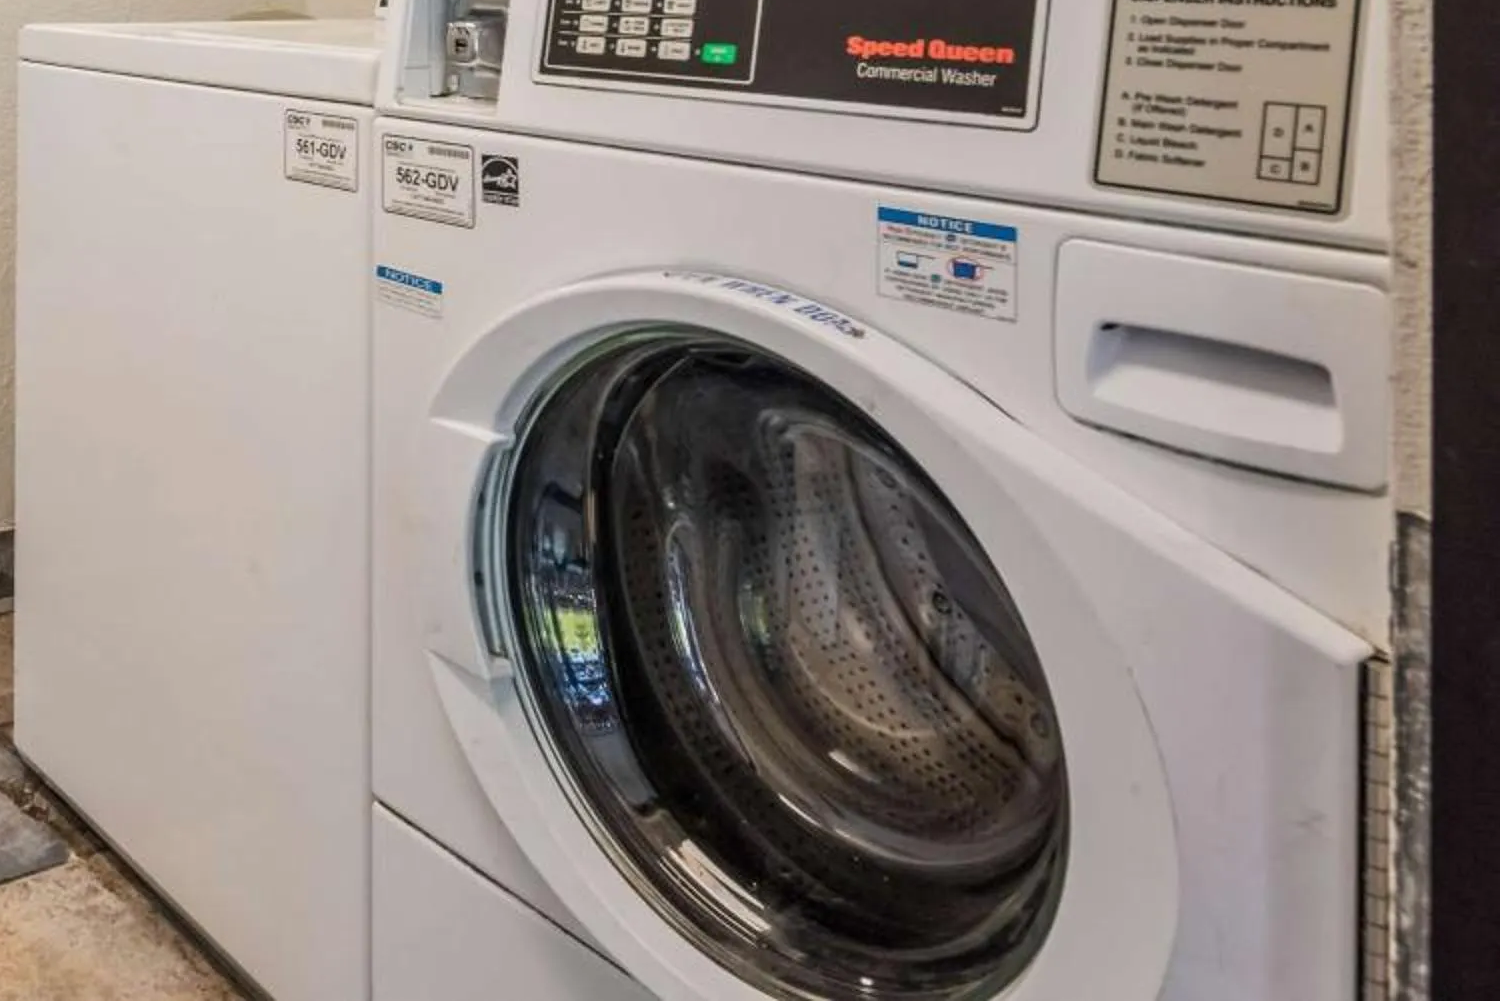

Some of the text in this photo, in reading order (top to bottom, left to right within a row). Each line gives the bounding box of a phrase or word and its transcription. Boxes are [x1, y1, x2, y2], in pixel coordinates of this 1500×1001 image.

[1141, 15, 1166, 26] Open
[1169, 16, 1218, 28] Dispenser
[1220, 18, 1245, 29] Door
[846, 35, 1016, 64] Speed Queen
[1136, 46, 1149, 54] as
[1138, 33, 1163, 43] Load
[1166, 34, 1207, 46] Supplies
[1209, 36, 1218, 45] in
[1220, 36, 1255, 49] Proper
[1257, 39, 1331, 52] Compartment
[1136, 57, 1164, 67] Close
[1166, 58, 1215, 71] Dispenser
[1218, 61, 1242, 73] Door
[856, 62, 997, 87] Commercial Washer
[1155, 93, 1182, 104] Wash
[1186, 96, 1239, 110] Detergent
[1130, 119, 1156, 129] Main
[1158, 121, 1186, 132] Wash
[1190, 124, 1242, 139] Detergent
[1273, 127, 1285, 139] D
[1304, 123, 1315, 133] A
[296, 138, 347, 160] 561-GDV
[1130, 135, 1160, 147] Liquid
[1162, 137, 1198, 149] Bleach
[1128, 151, 1159, 163] Fabric
[1162, 153, 1206, 167] Softener
[1300, 161, 1311, 172] B
[1270, 163, 1281, 175] C
[395, 166, 459, 192] 562-GDV
[917, 214, 973, 234] NOTICE
